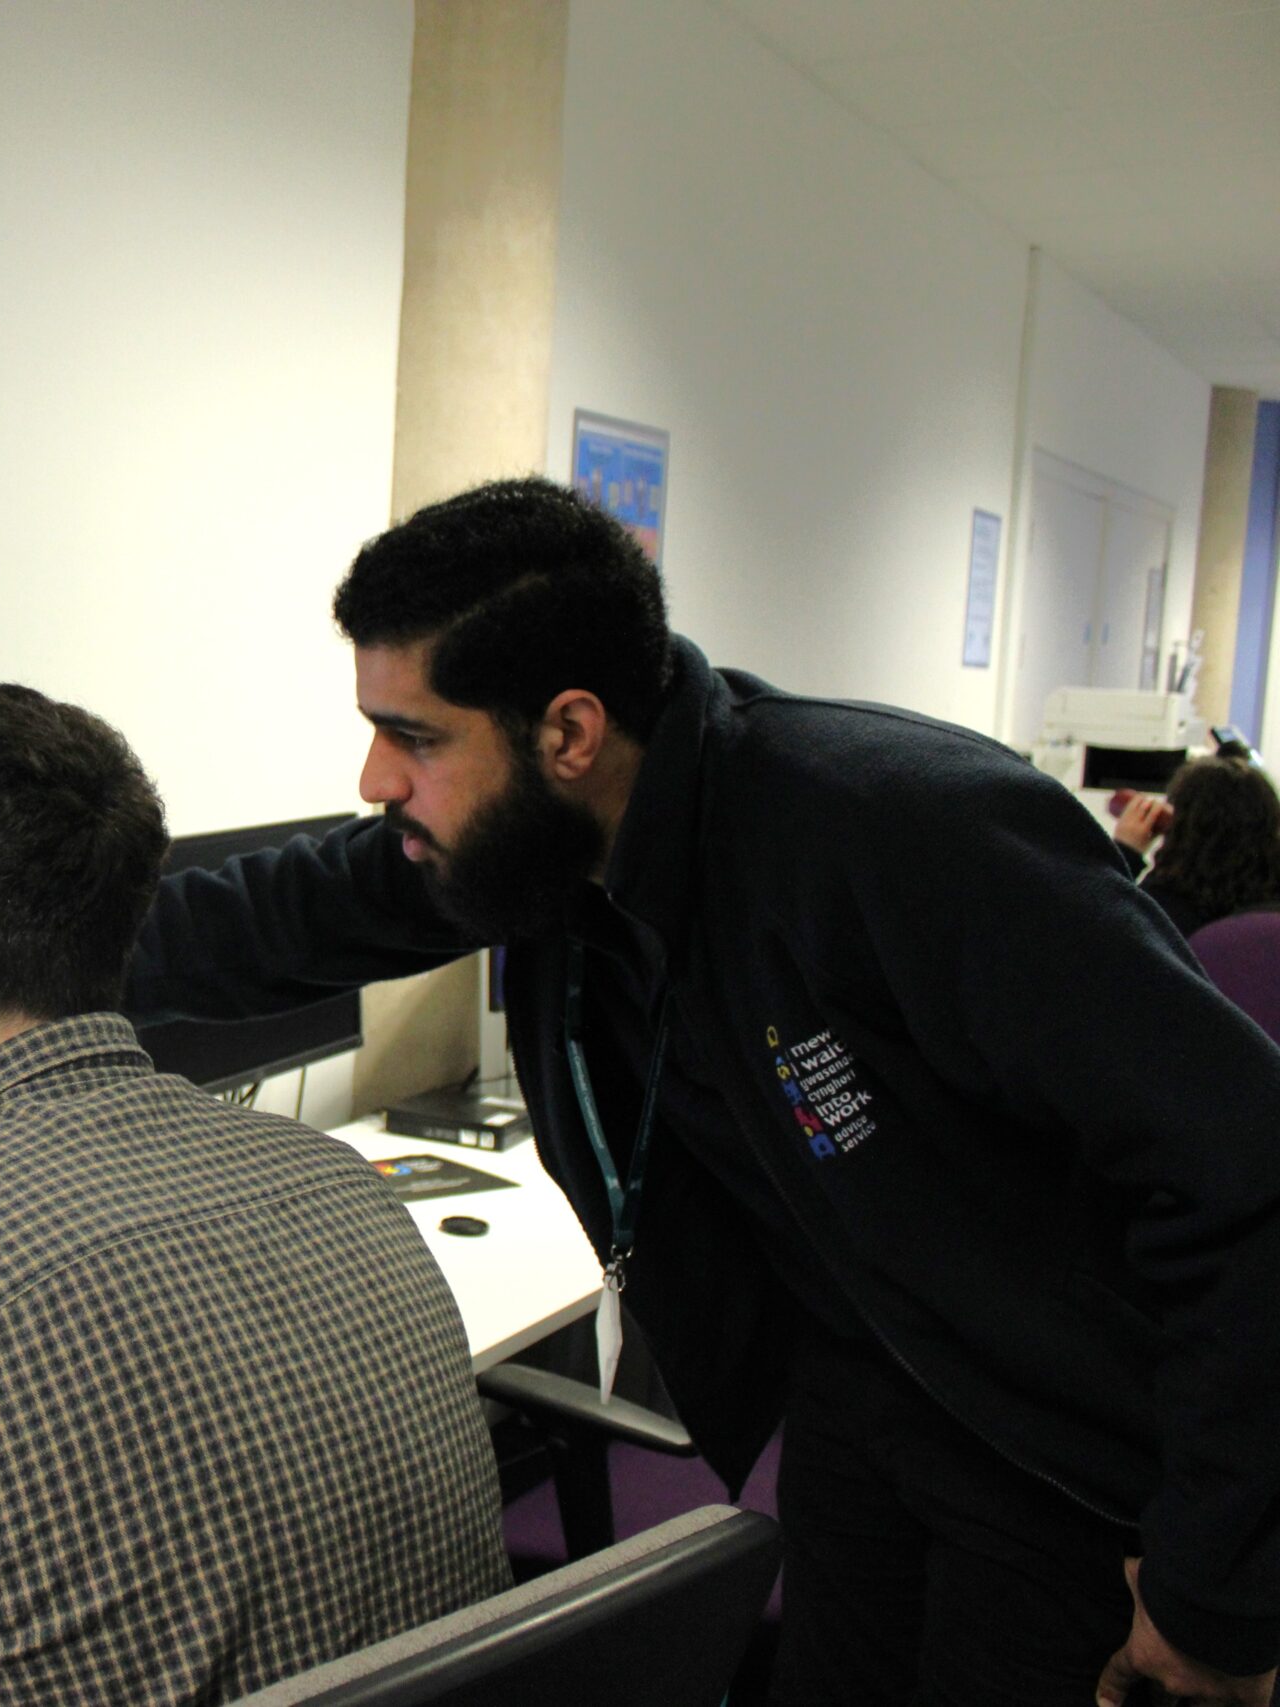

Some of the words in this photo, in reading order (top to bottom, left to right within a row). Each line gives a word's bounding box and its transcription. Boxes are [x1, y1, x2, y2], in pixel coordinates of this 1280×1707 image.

[823, 1089, 872, 1128] work
[834, 1114, 869, 1143] advice
[841, 1121, 877, 1153] service
